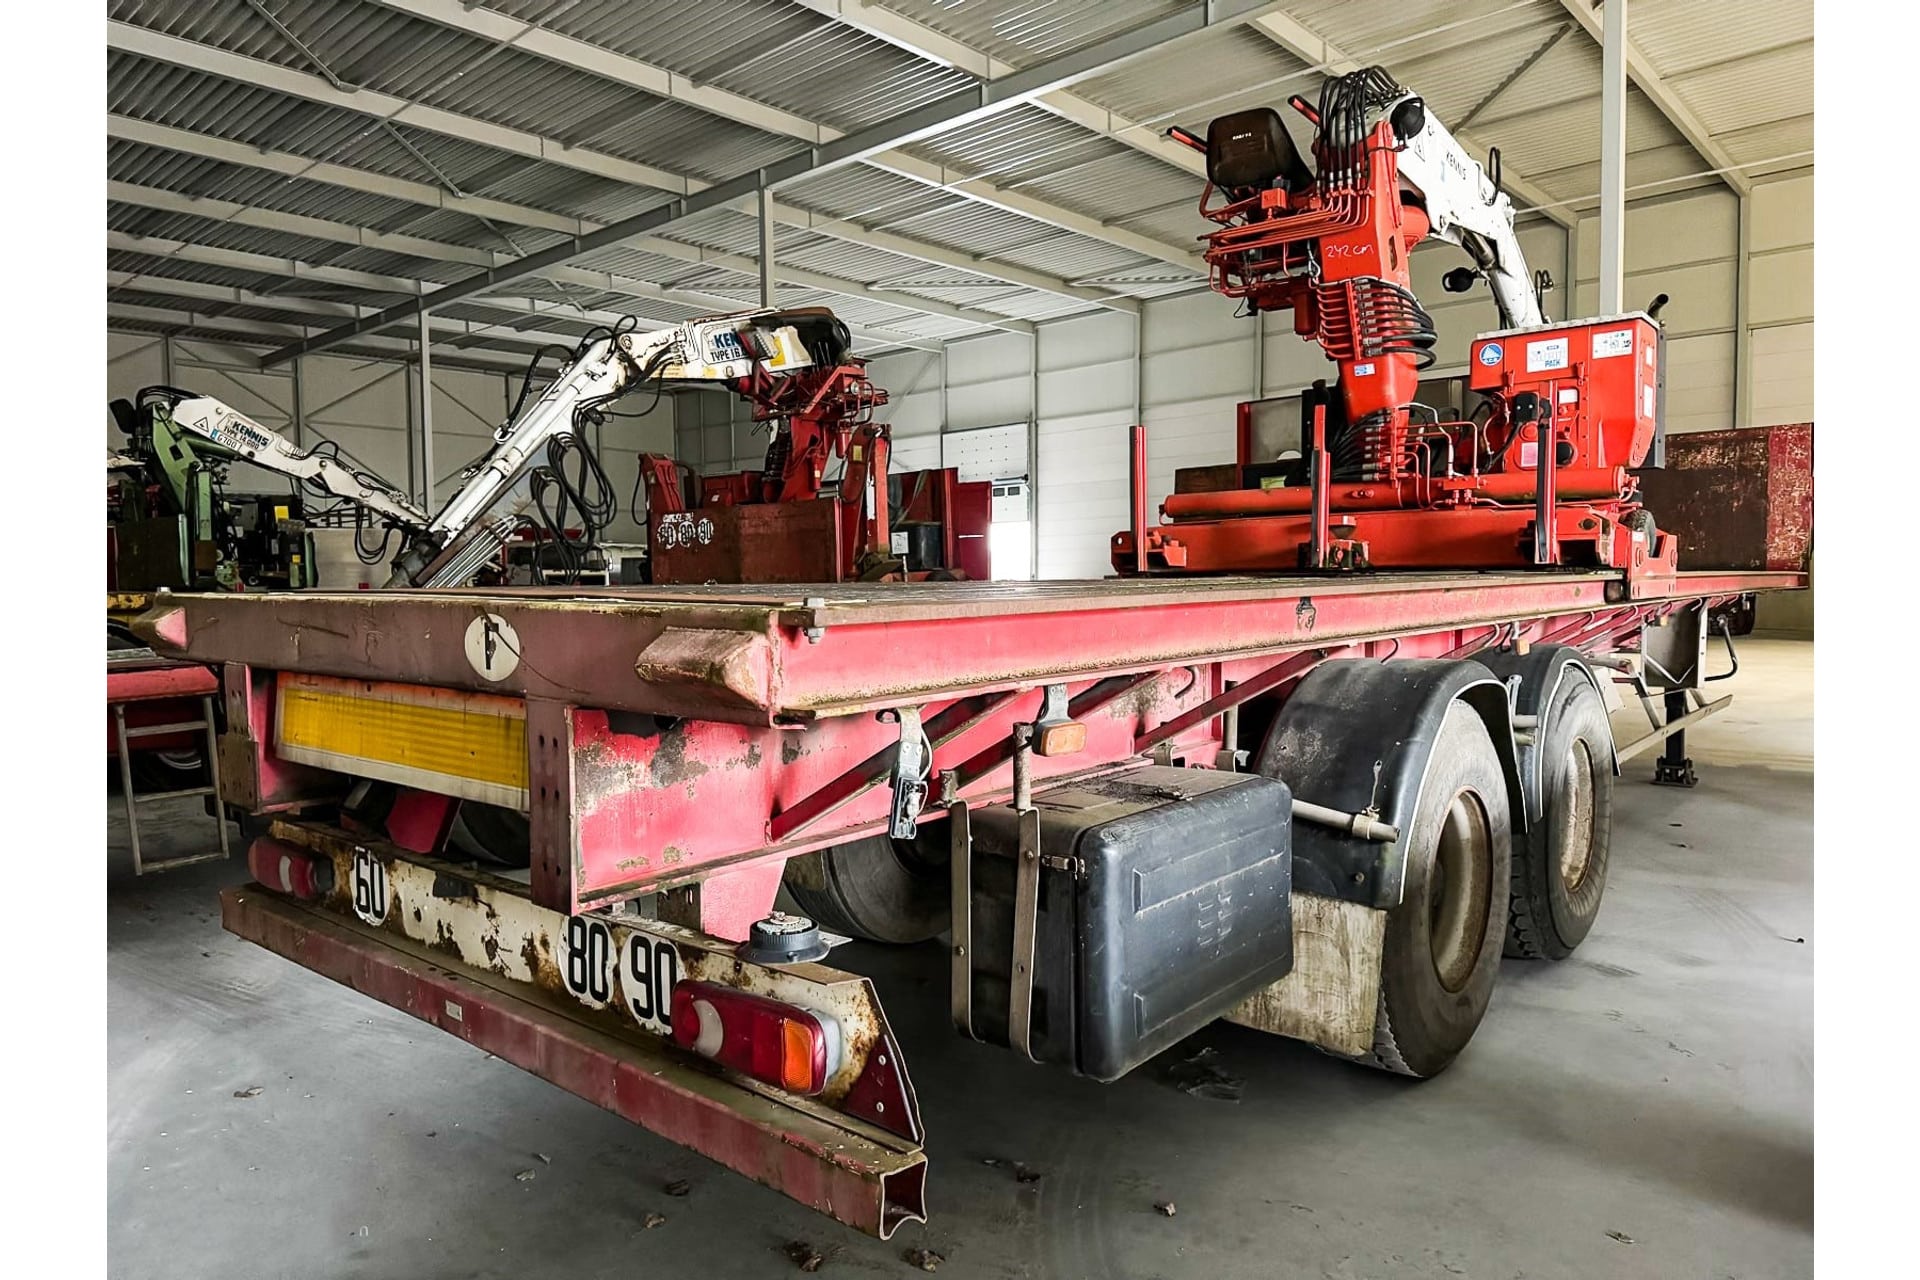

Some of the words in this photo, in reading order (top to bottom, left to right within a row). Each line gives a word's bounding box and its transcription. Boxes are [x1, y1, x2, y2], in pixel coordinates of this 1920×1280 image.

[1325, 244, 1352, 258] 242
[710, 349, 730, 362] TYPE
[232, 420, 269, 446] KENNIS
[355, 852, 386, 919] 60
[567, 915, 610, 1003] 80
[630, 934, 678, 1027] 90
